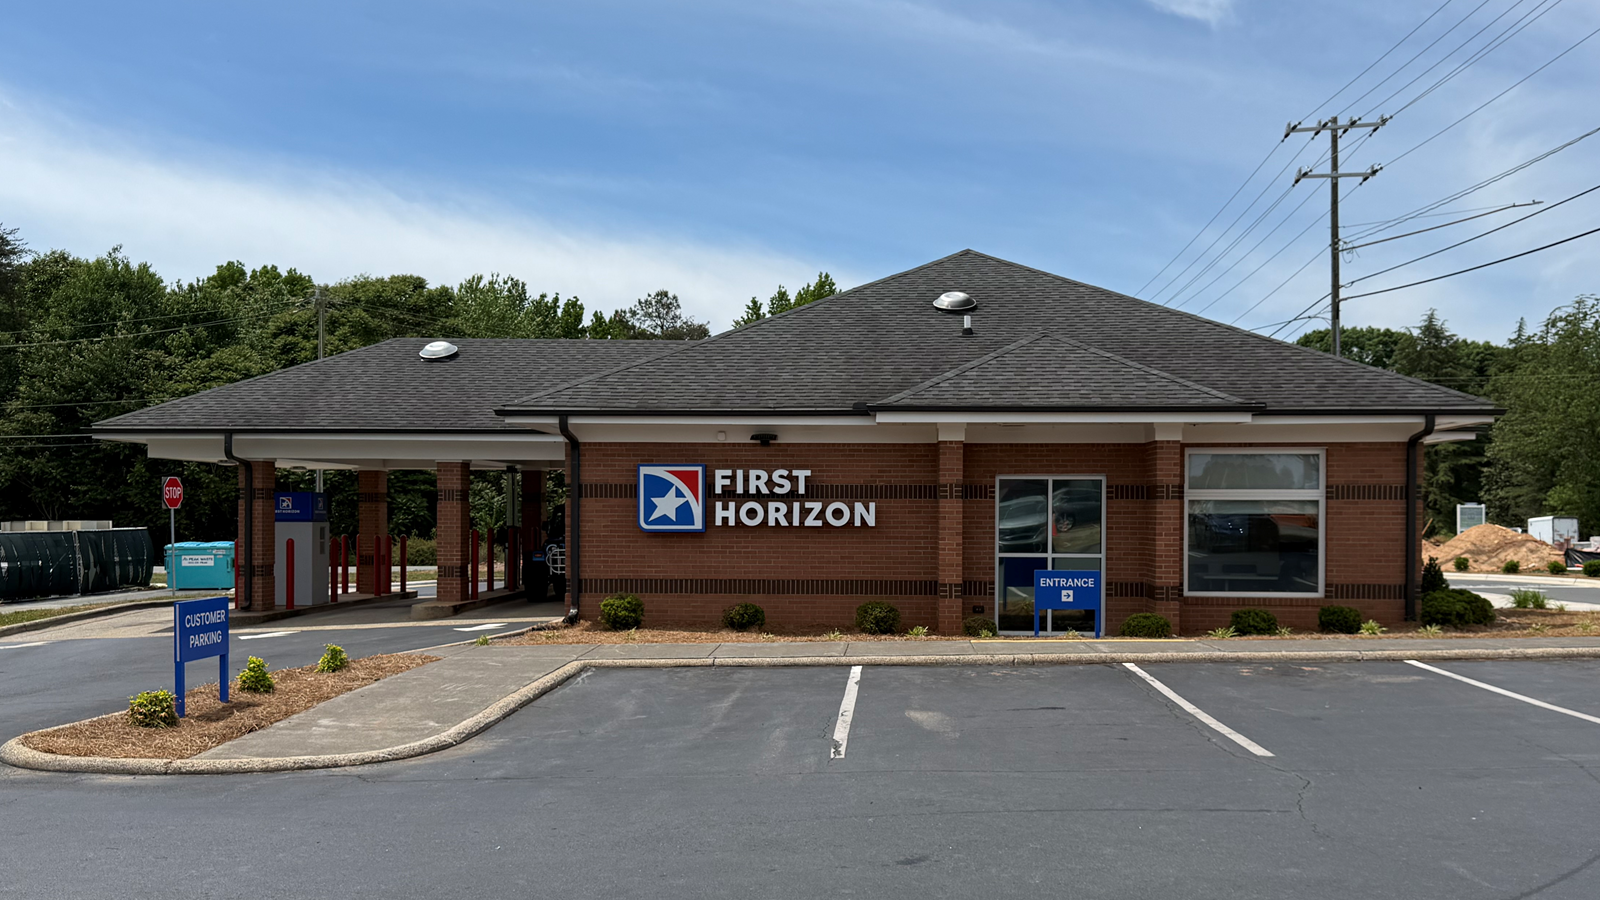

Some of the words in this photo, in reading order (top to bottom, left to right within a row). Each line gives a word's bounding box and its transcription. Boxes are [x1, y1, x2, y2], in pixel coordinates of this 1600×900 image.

[715, 469, 812, 495] FIRST
[165, 487, 181, 499] STOP
[715, 501, 876, 527] HORIZON
[1040, 577, 1095, 588] ENTRANCE
[185, 609, 226, 628] CUSTOMER
[189, 630, 222, 649] PARKING
